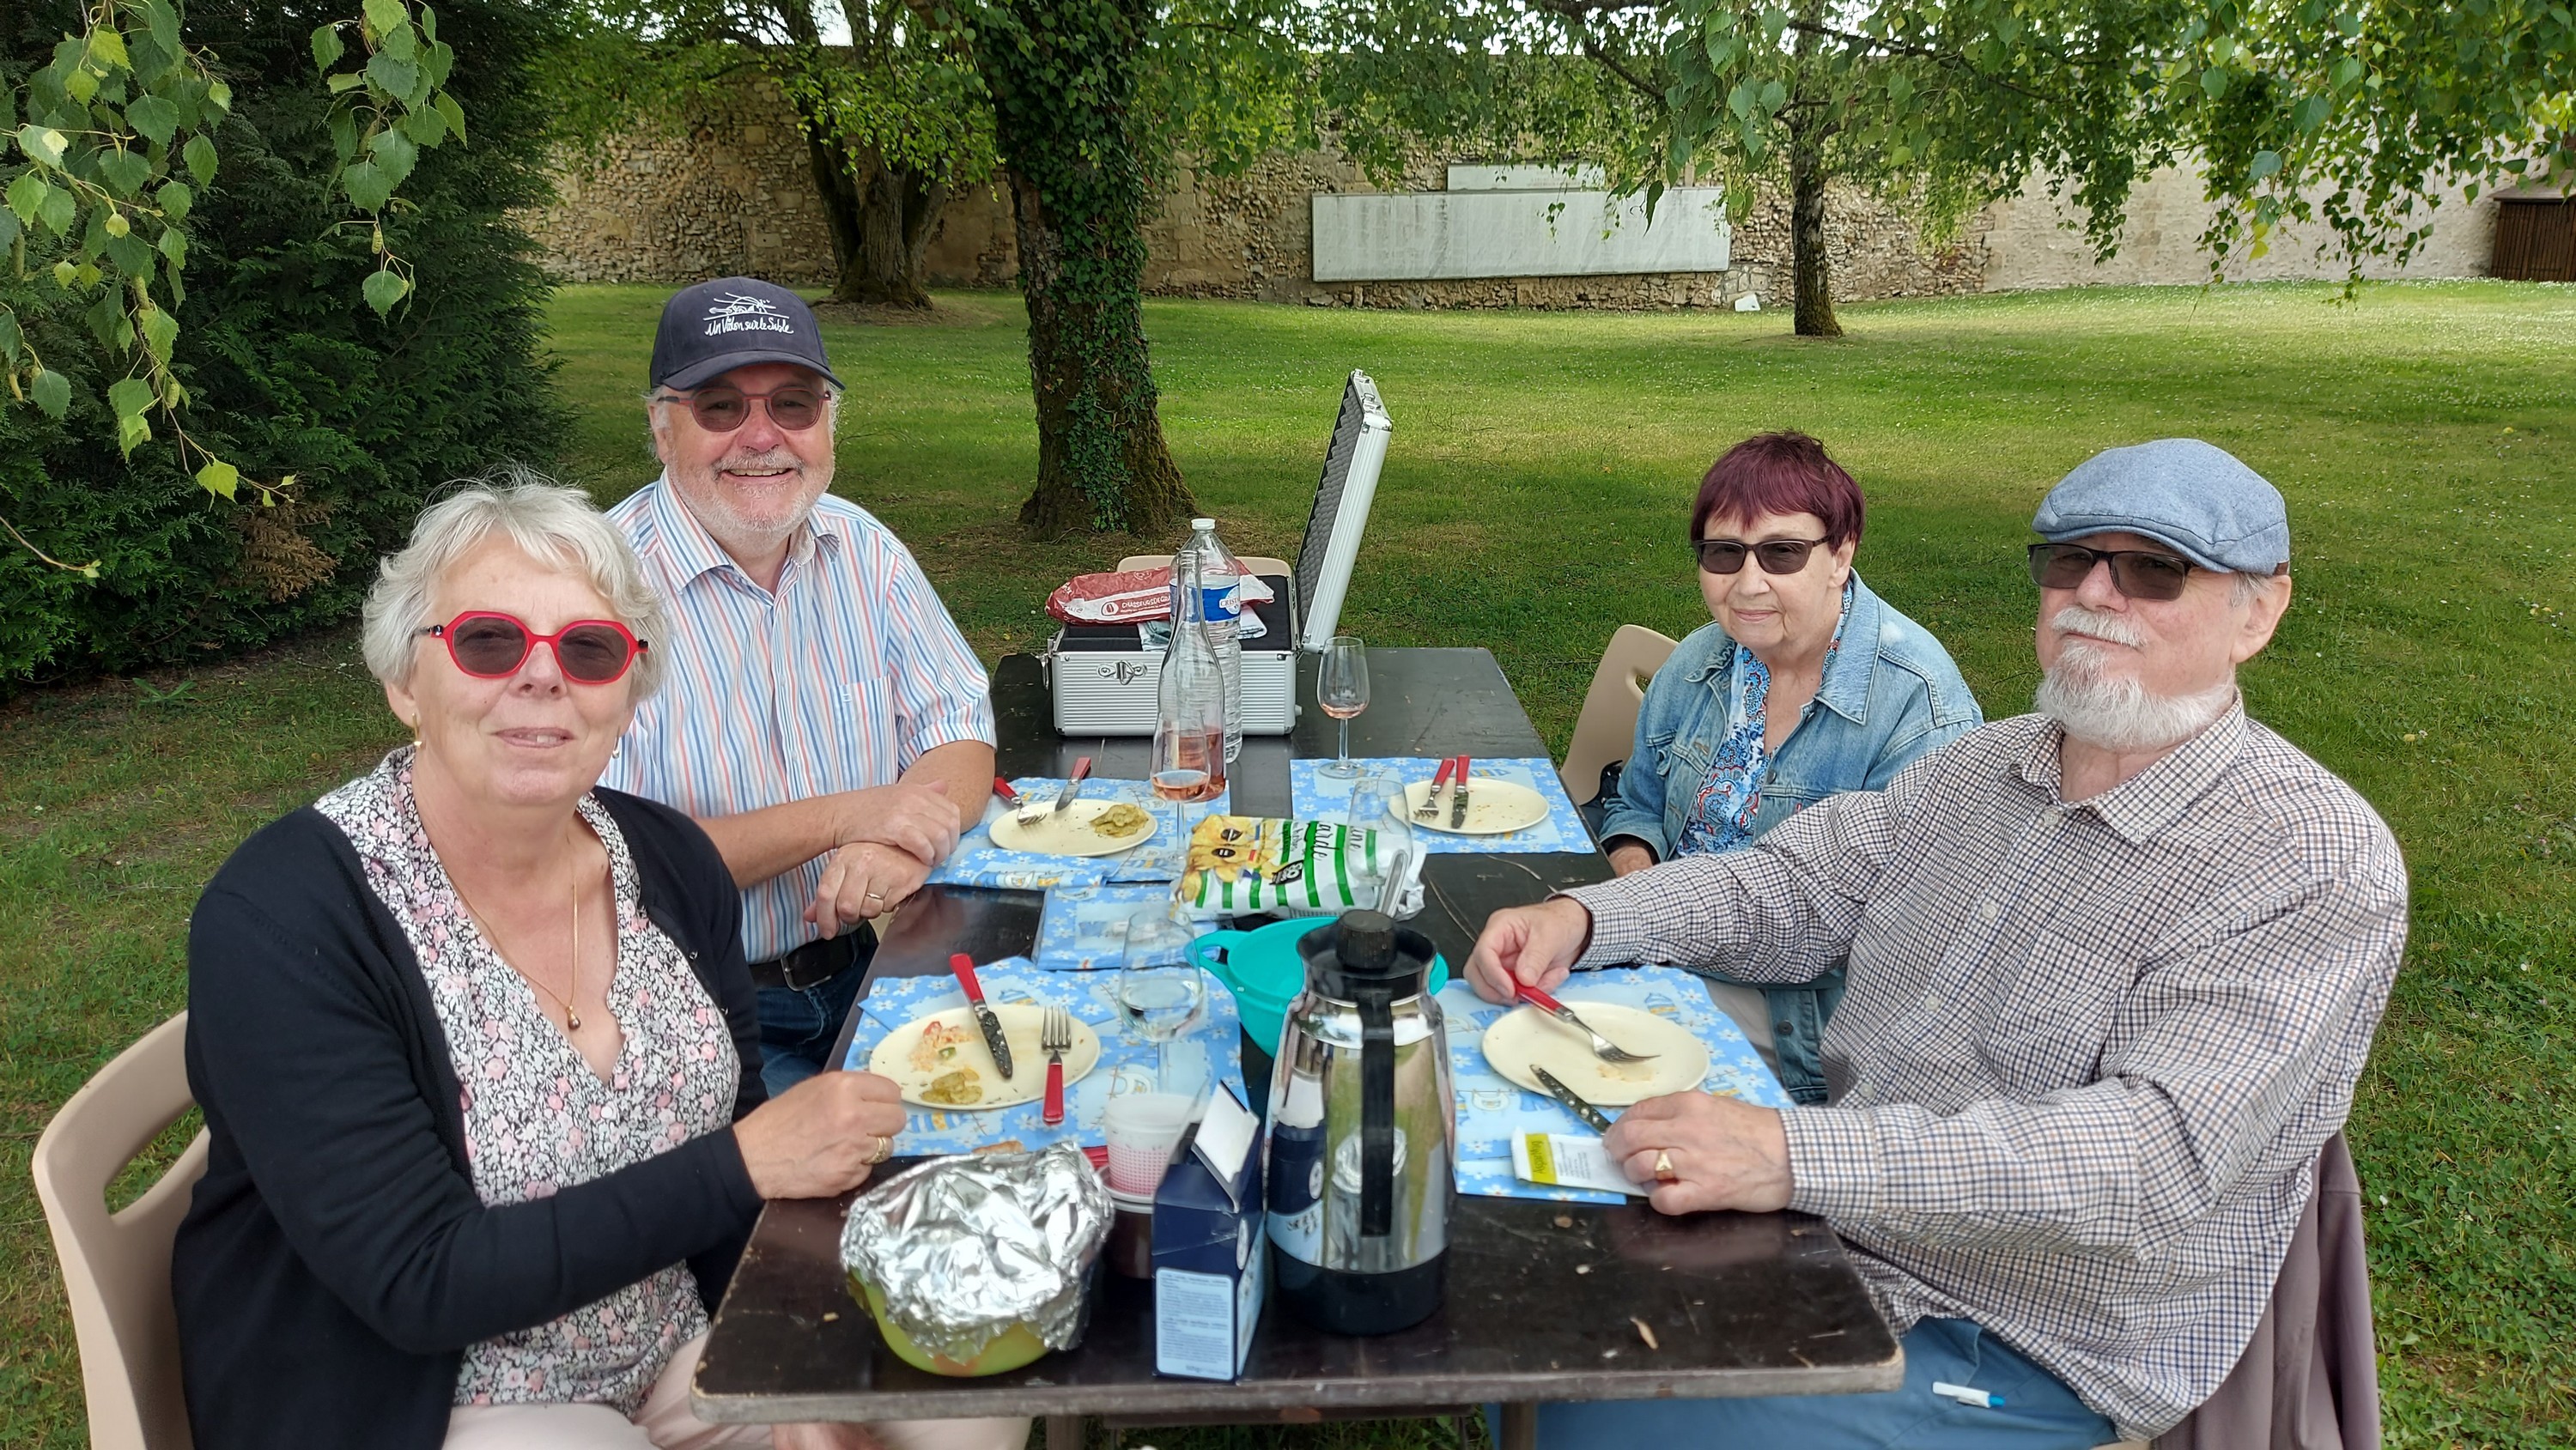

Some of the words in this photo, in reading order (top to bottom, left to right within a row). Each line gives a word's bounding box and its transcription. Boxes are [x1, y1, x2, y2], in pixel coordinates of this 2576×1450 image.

[704, 320, 721, 336] Un
[722, 316, 744, 332] Violon
[744, 321, 760, 331] sur
[759, 317, 768, 331] le
[767, 317, 794, 334] Sable
